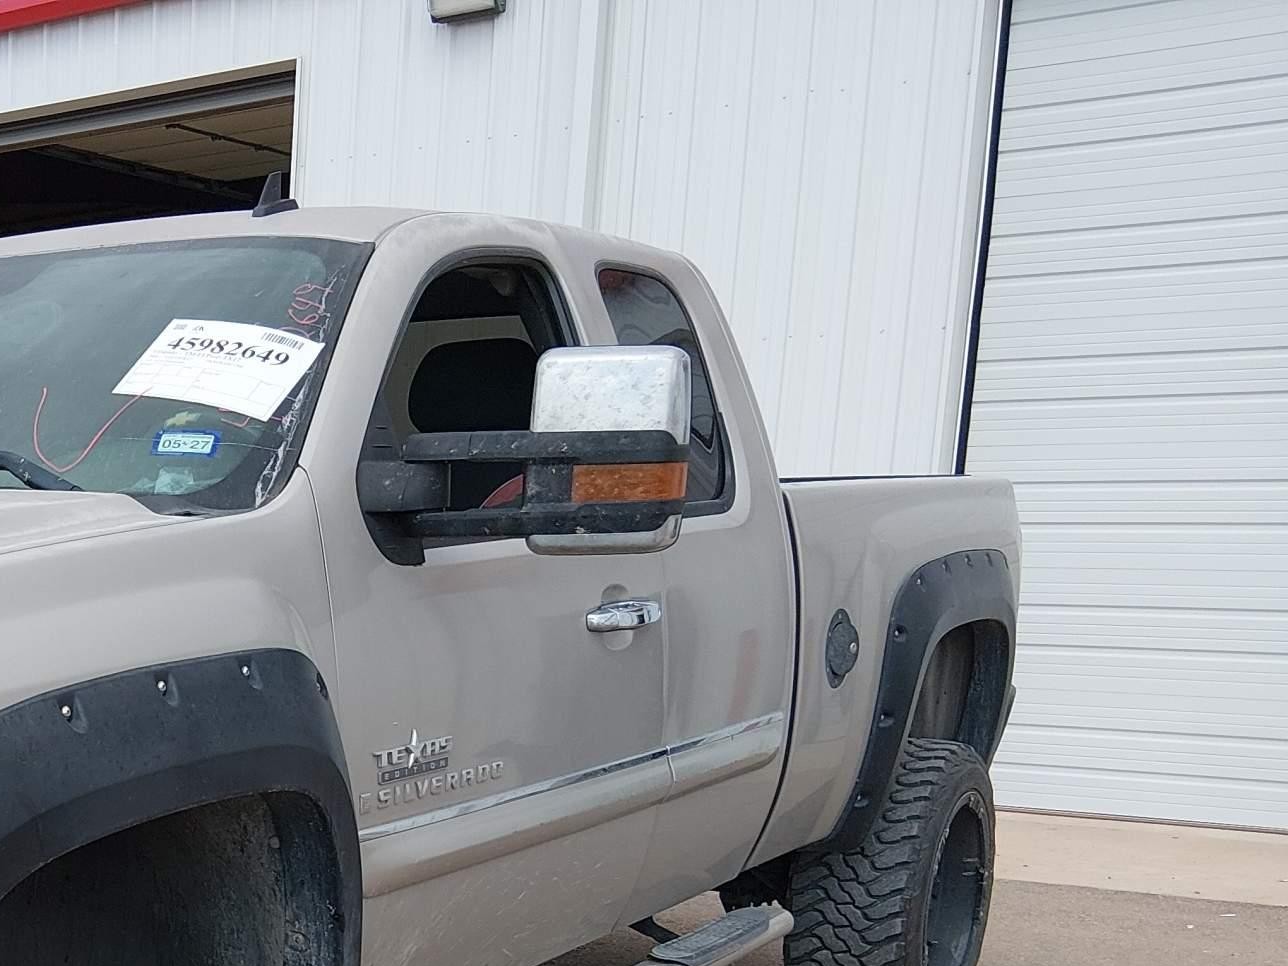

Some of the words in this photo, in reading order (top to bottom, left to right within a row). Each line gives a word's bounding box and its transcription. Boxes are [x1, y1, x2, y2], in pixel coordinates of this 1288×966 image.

[167, 335, 290, 367] 45982649
[372, 728, 453, 768] TEXAS
[377, 761, 504, 809] SILVERADO
[383, 760, 447, 781] EDITION
